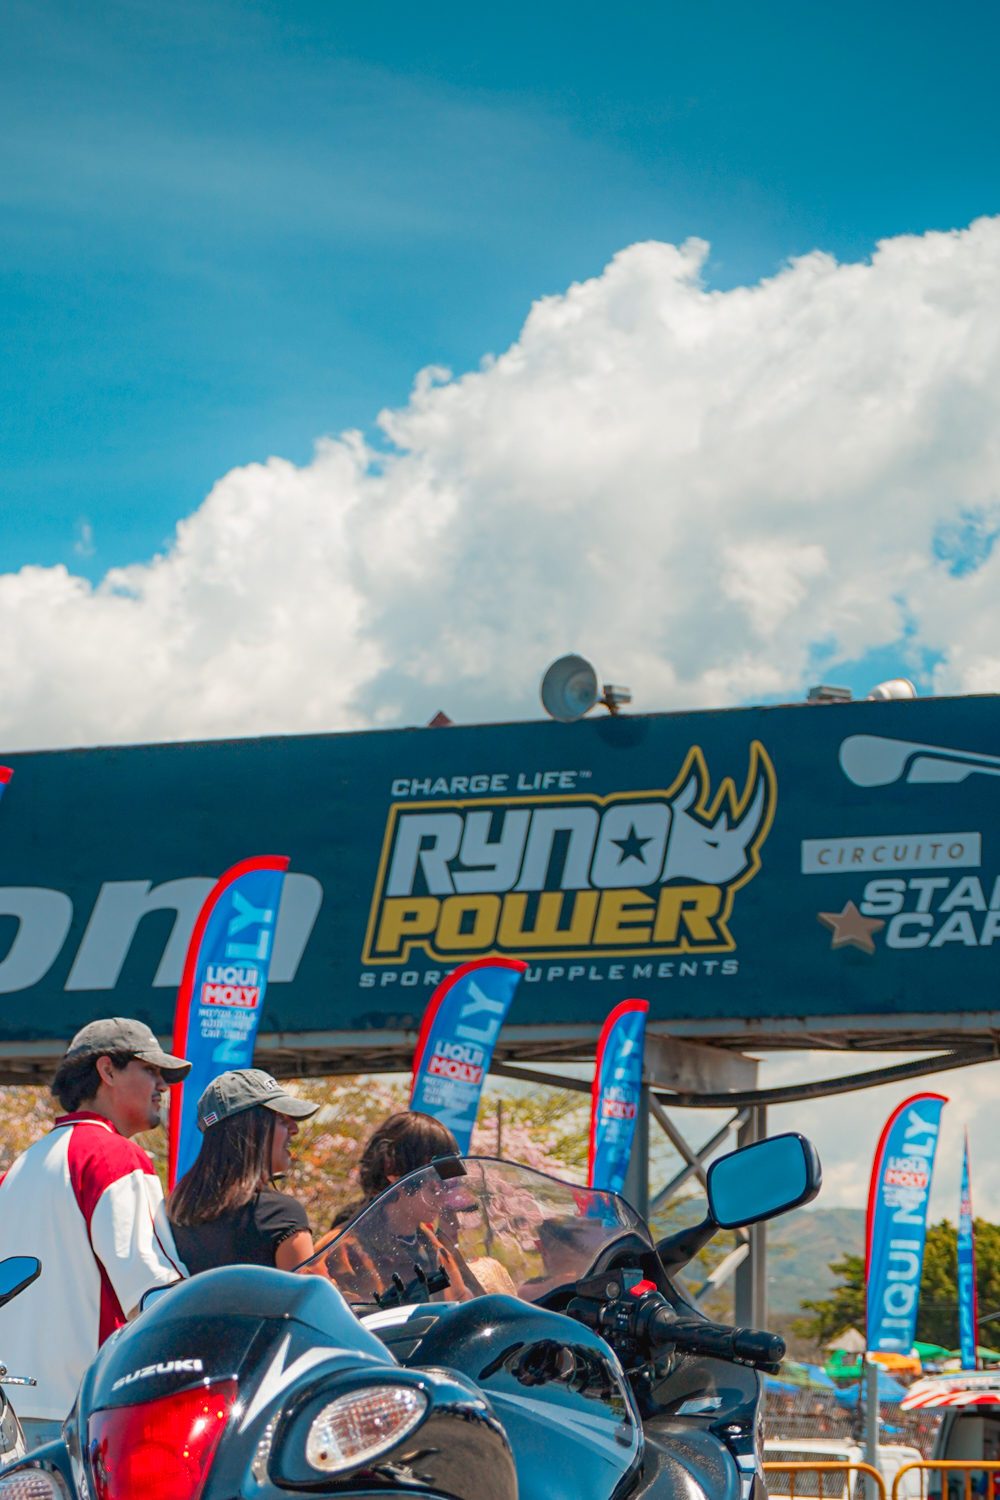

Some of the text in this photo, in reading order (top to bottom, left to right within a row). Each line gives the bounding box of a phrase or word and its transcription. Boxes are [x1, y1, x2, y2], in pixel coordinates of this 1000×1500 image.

[391, 774, 509, 797] CHARGE
[386, 802, 673, 896] RYNO
[817, 842, 964, 866] CIRCUITO
[375, 885, 722, 952] POWER
[206, 965, 259, 986] LIQUI
[359, 959, 739, 988] SPOR UPPLEMENTS
[204, 985, 257, 1006] MOLY
[434, 1040, 485, 1066] LIQUI
[430, 1058, 482, 1084] MOLY
[888, 1156, 928, 1174] LIQUI
[886, 1170, 927, 1187] MOLY
[878, 1239, 921, 1350] LIQUI
[111, 1359, 203, 1391] SUZUKI
